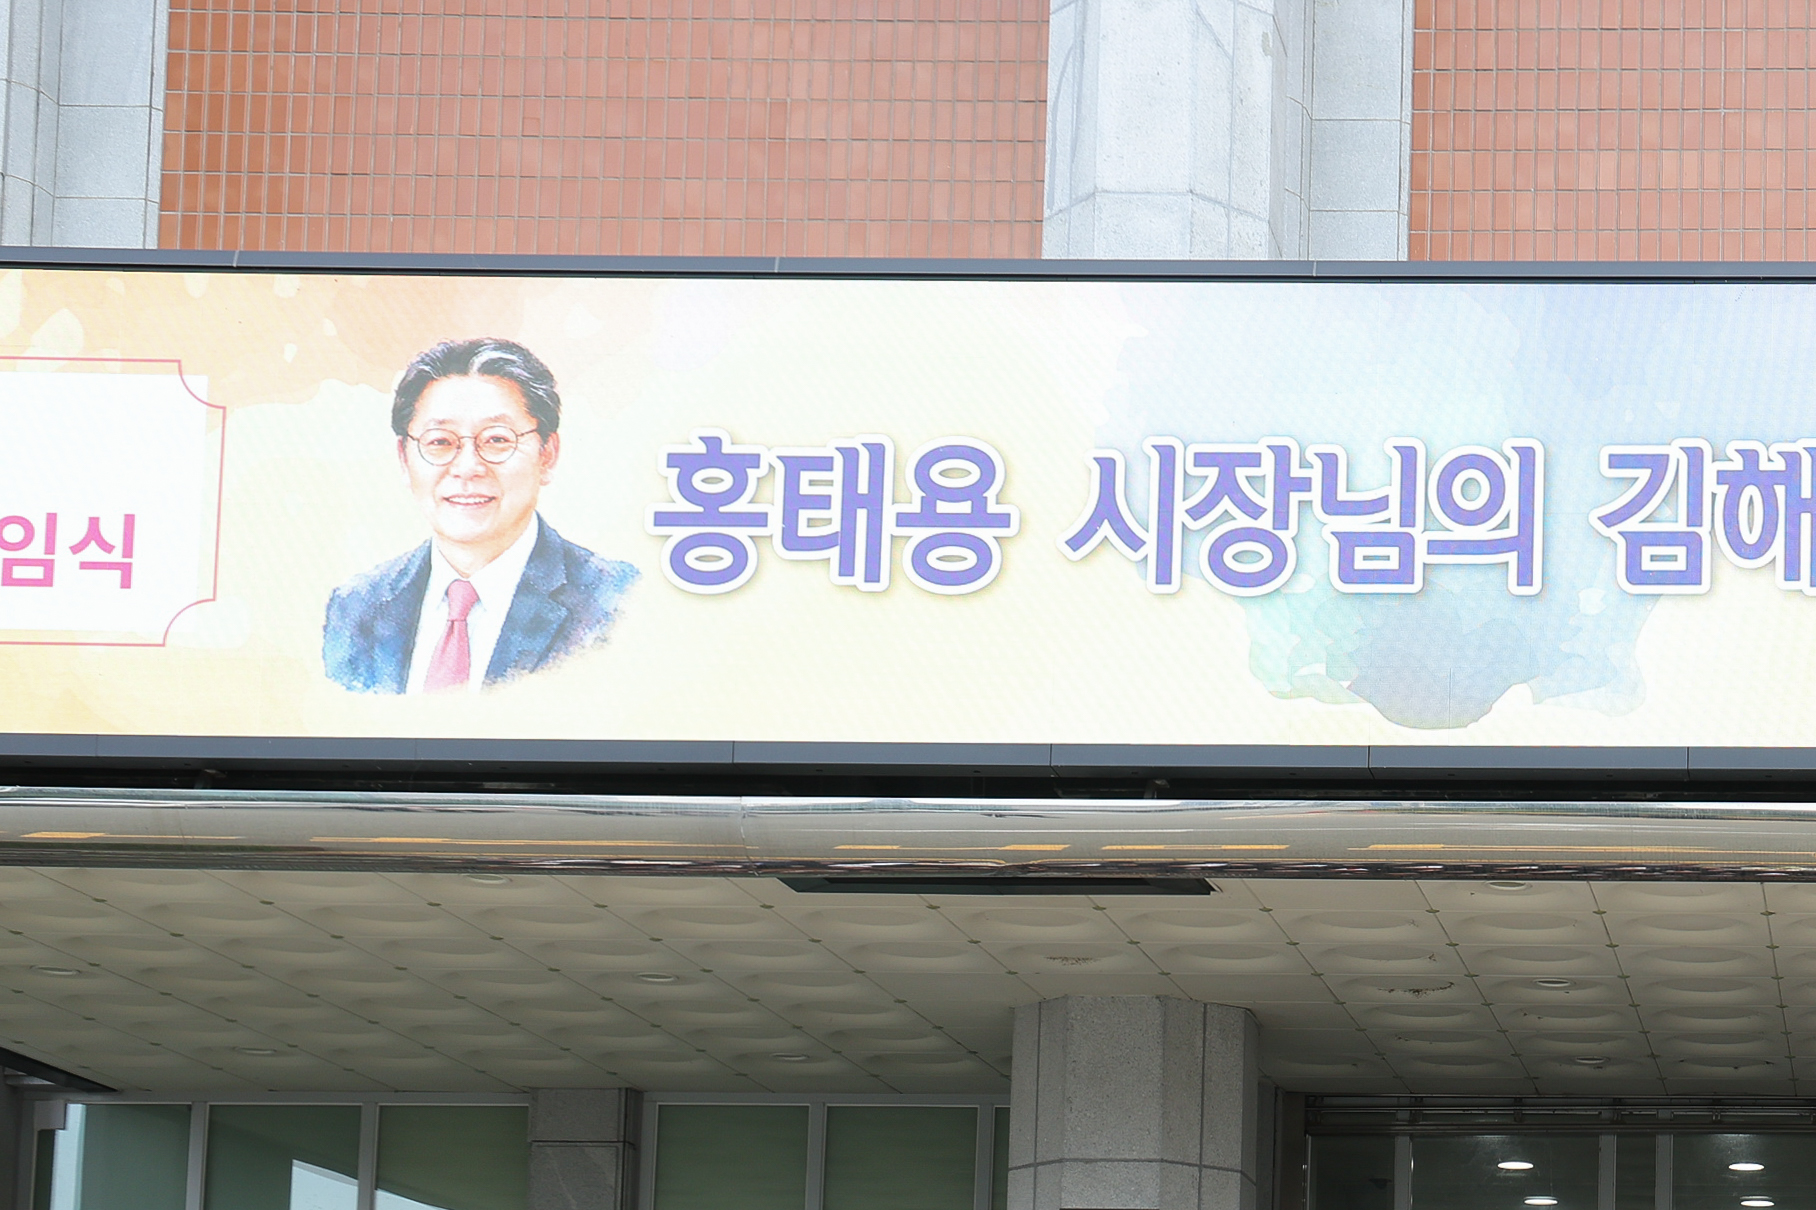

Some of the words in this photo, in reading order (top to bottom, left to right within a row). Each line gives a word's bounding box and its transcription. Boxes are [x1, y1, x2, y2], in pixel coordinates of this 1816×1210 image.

[0, 512, 135, 589] 임식
[649, 432, 1014, 589] 홍태용
[1062, 442, 1541, 589] 시장님의
